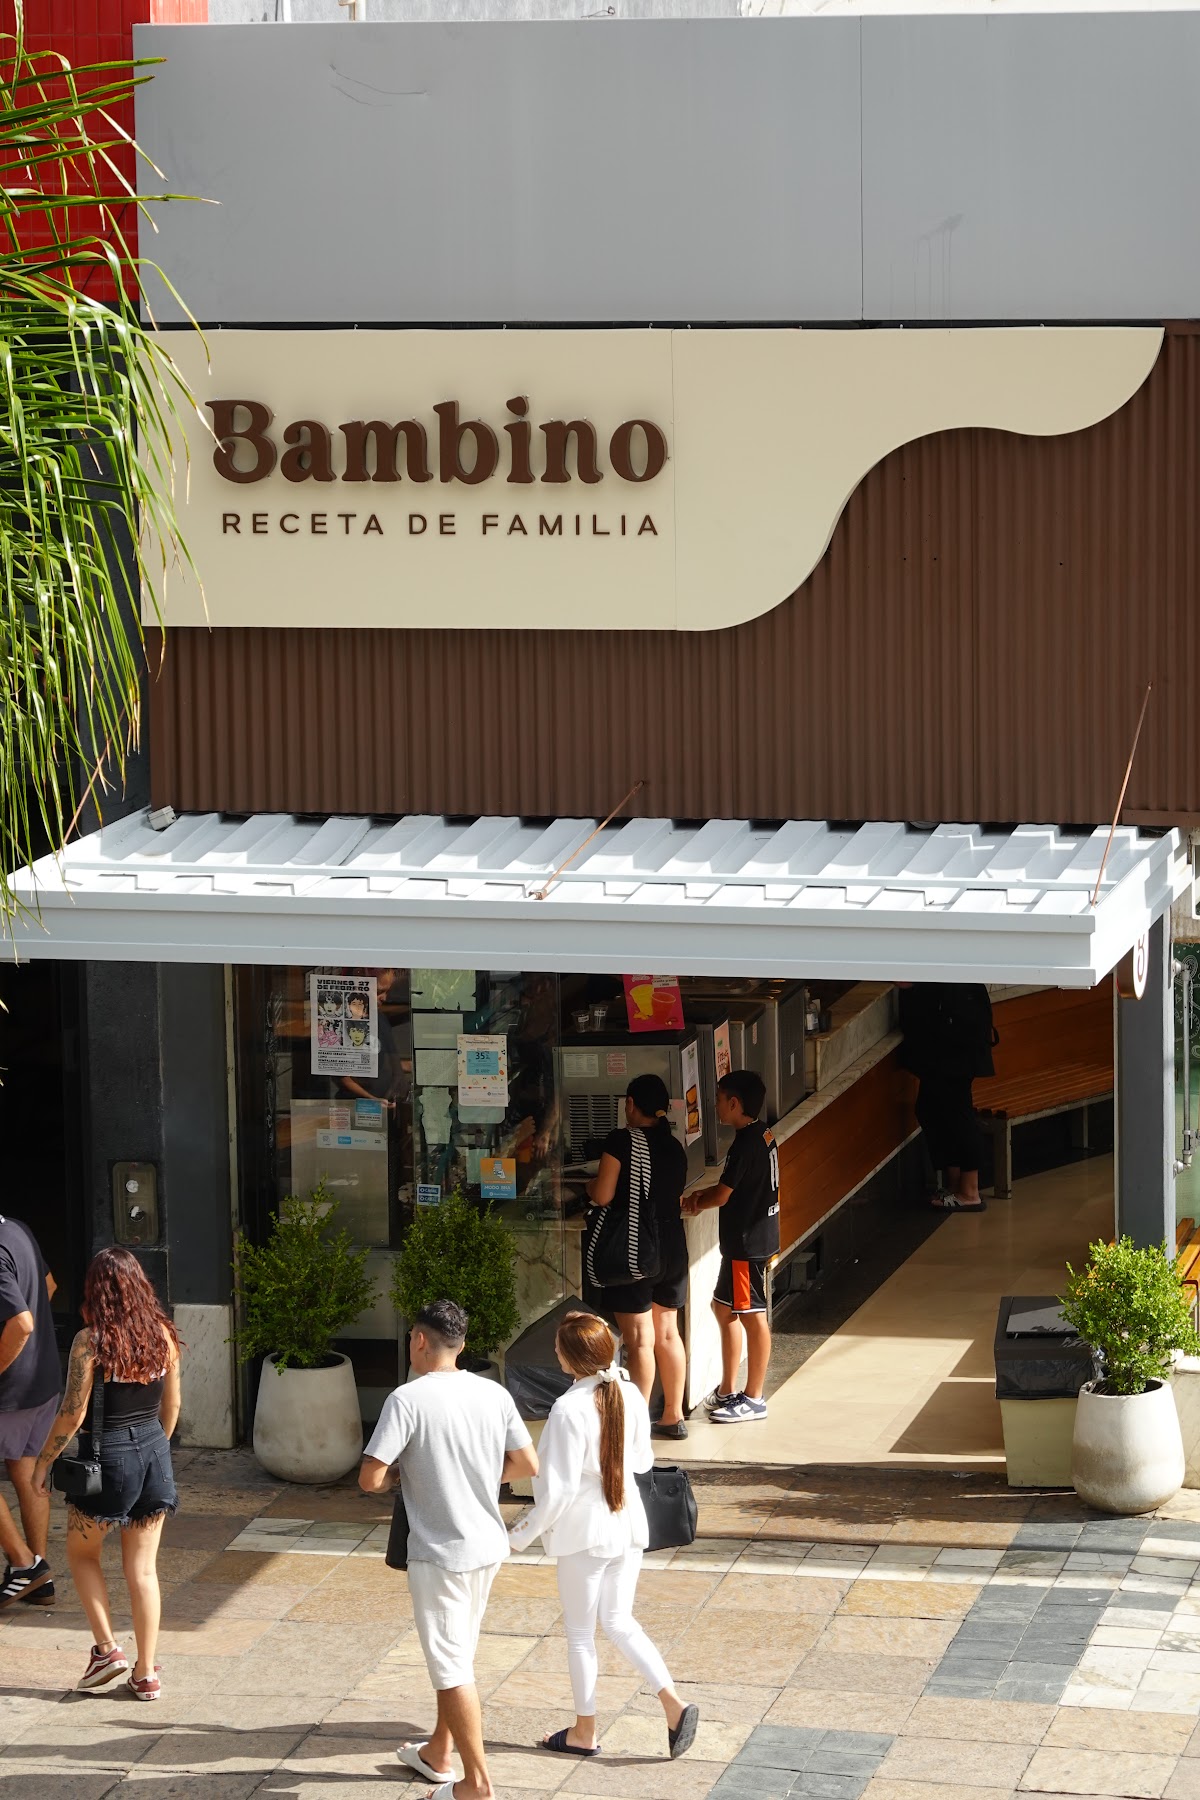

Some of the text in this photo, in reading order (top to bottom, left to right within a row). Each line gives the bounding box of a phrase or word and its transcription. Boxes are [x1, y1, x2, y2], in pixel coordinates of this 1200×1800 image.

[205, 395, 668, 484] Bambino
[222, 513, 658, 536] RECETA DE FAMILIA
